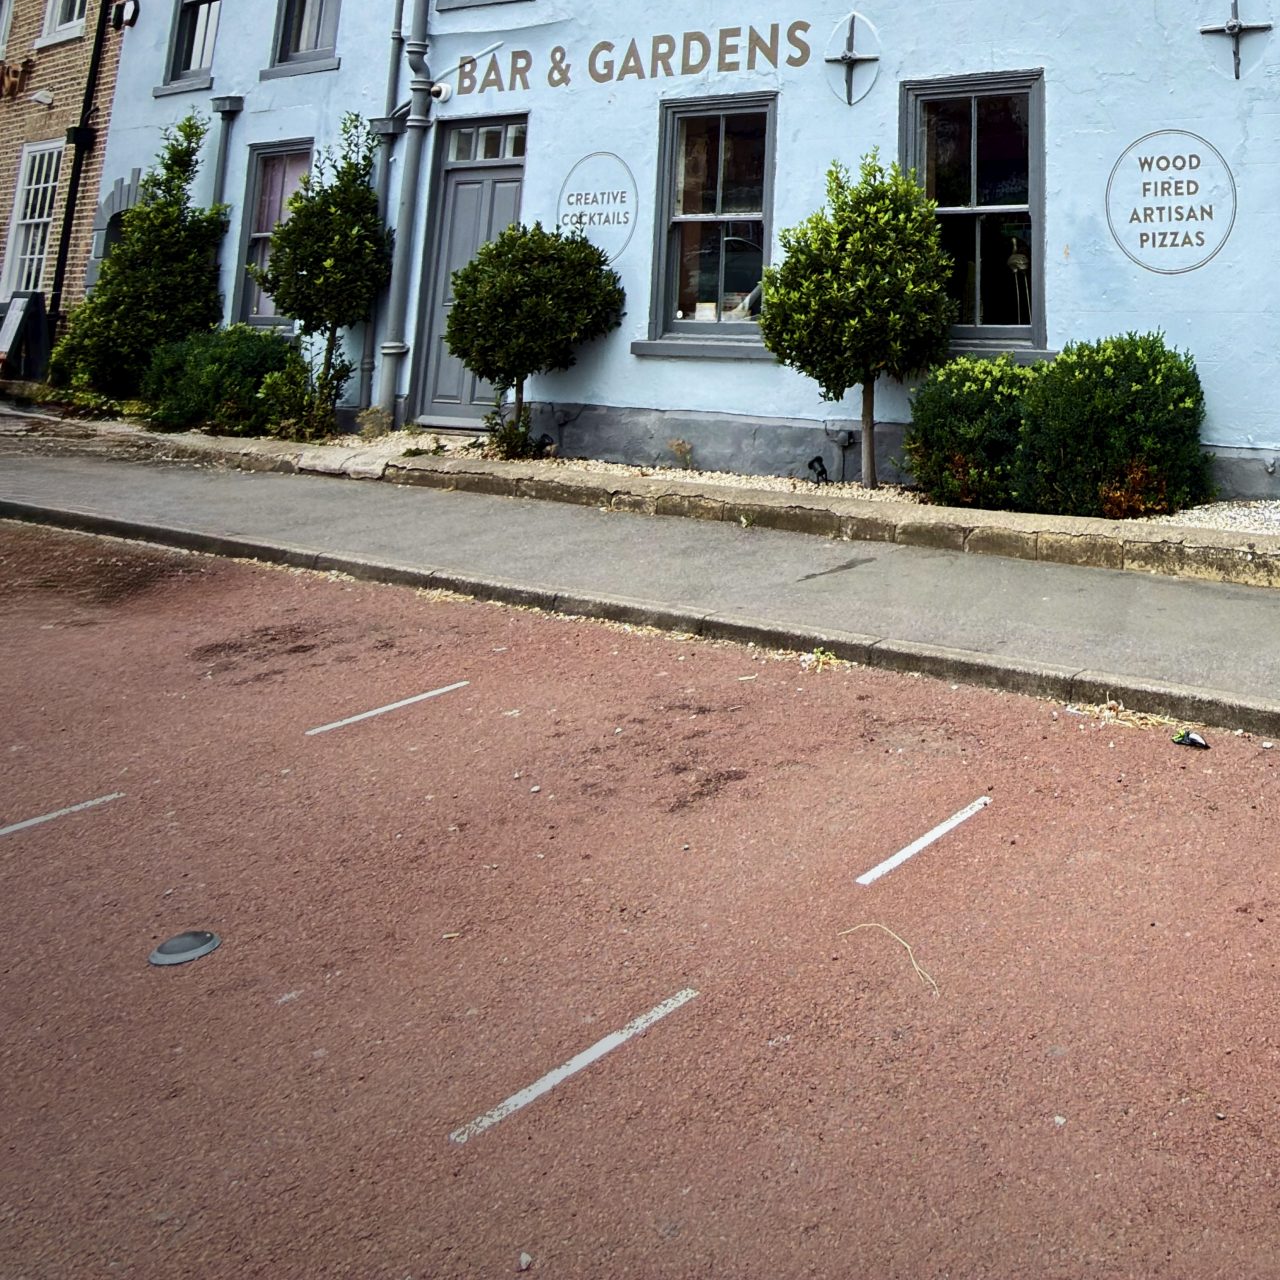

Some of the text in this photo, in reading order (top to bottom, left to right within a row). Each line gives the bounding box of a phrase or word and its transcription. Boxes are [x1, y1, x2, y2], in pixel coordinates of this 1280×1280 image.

[456, 19, 812, 96] BAR & GARDENS
[1138, 153, 1201, 173] WOOD
[566, 190, 627, 206] CREATIVE
[1142, 179, 1200, 198] FIRED
[561, 211, 630, 226] COCKTAILS
[1128, 204, 1214, 224] ARTISAN
[1139, 230, 1205, 249] PIZZAS
